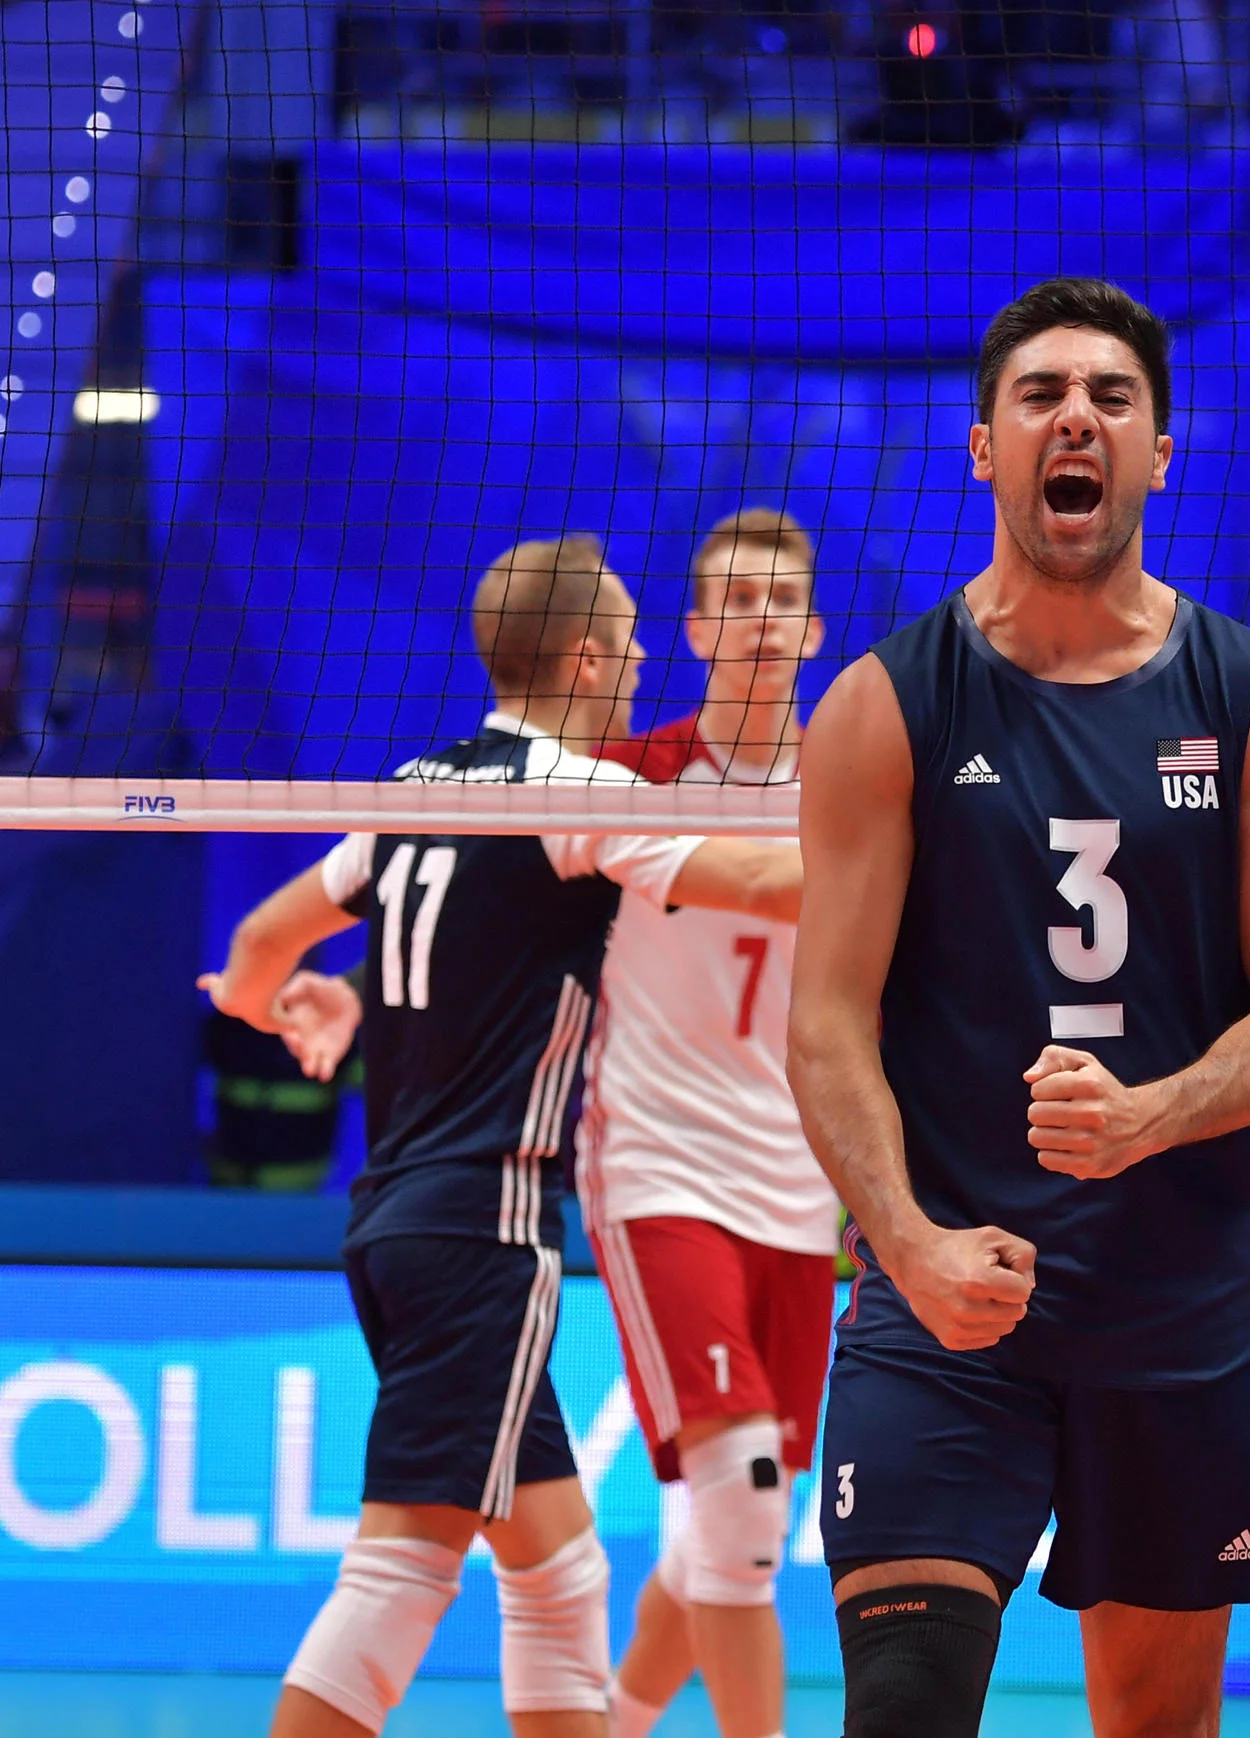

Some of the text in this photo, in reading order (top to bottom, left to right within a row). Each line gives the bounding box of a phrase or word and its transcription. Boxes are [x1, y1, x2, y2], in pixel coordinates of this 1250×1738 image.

[124, 795, 176, 813] FIVB
[954, 771, 1001, 785] adidas
[1161, 775, 1219, 810] USA
[376, 842, 457, 1010] 11
[1047, 817, 1128, 983] 3
[733, 935, 769, 1038] 7
[707, 1343, 731, 1394] 1
[835, 1462, 855, 1519] 3
